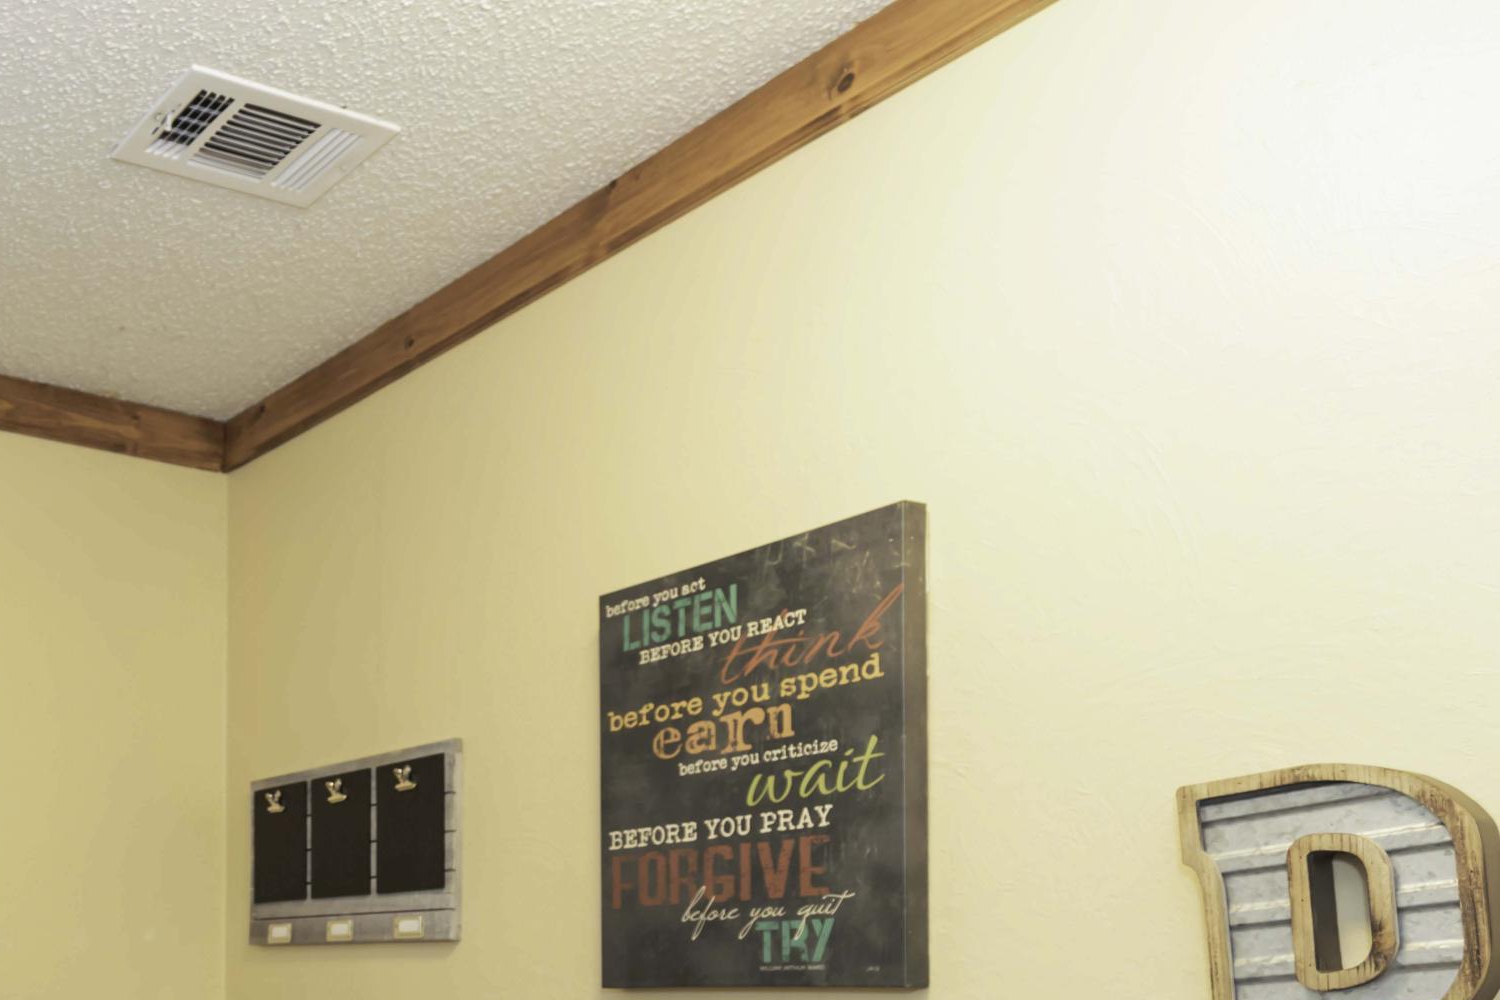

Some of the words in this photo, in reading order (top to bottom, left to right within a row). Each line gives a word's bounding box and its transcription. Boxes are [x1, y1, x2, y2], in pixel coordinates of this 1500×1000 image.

[606, 595, 650, 618] before
[652, 586, 678, 607] you
[681, 577, 706, 596] act
[623, 583, 738, 652] LISTEN
[638, 635, 704, 665] BEFORE
[708, 625, 742, 647] YOU
[747, 608, 807, 638] REACT
[721, 582, 905, 686] think
[607, 696, 703, 732] before
[712, 682, 771, 716] you
[780, 652, 885, 700] spend
[652, 702, 796, 760] earn
[678, 758, 728, 776] before
[731, 752, 760, 771] you
[763, 738, 838, 763] criticize
[746, 734, 886, 807] wait
[608, 821, 698, 851] BEFORE
[704, 814, 753, 839] YOU
[760, 804, 833, 834] PRAY
[610, 834, 832, 910] FORGIVE
[681, 885, 741, 941] before
[738, 907, 787, 940] you
[793, 890, 856, 941] quit
[755, 917, 836, 964] TRY
